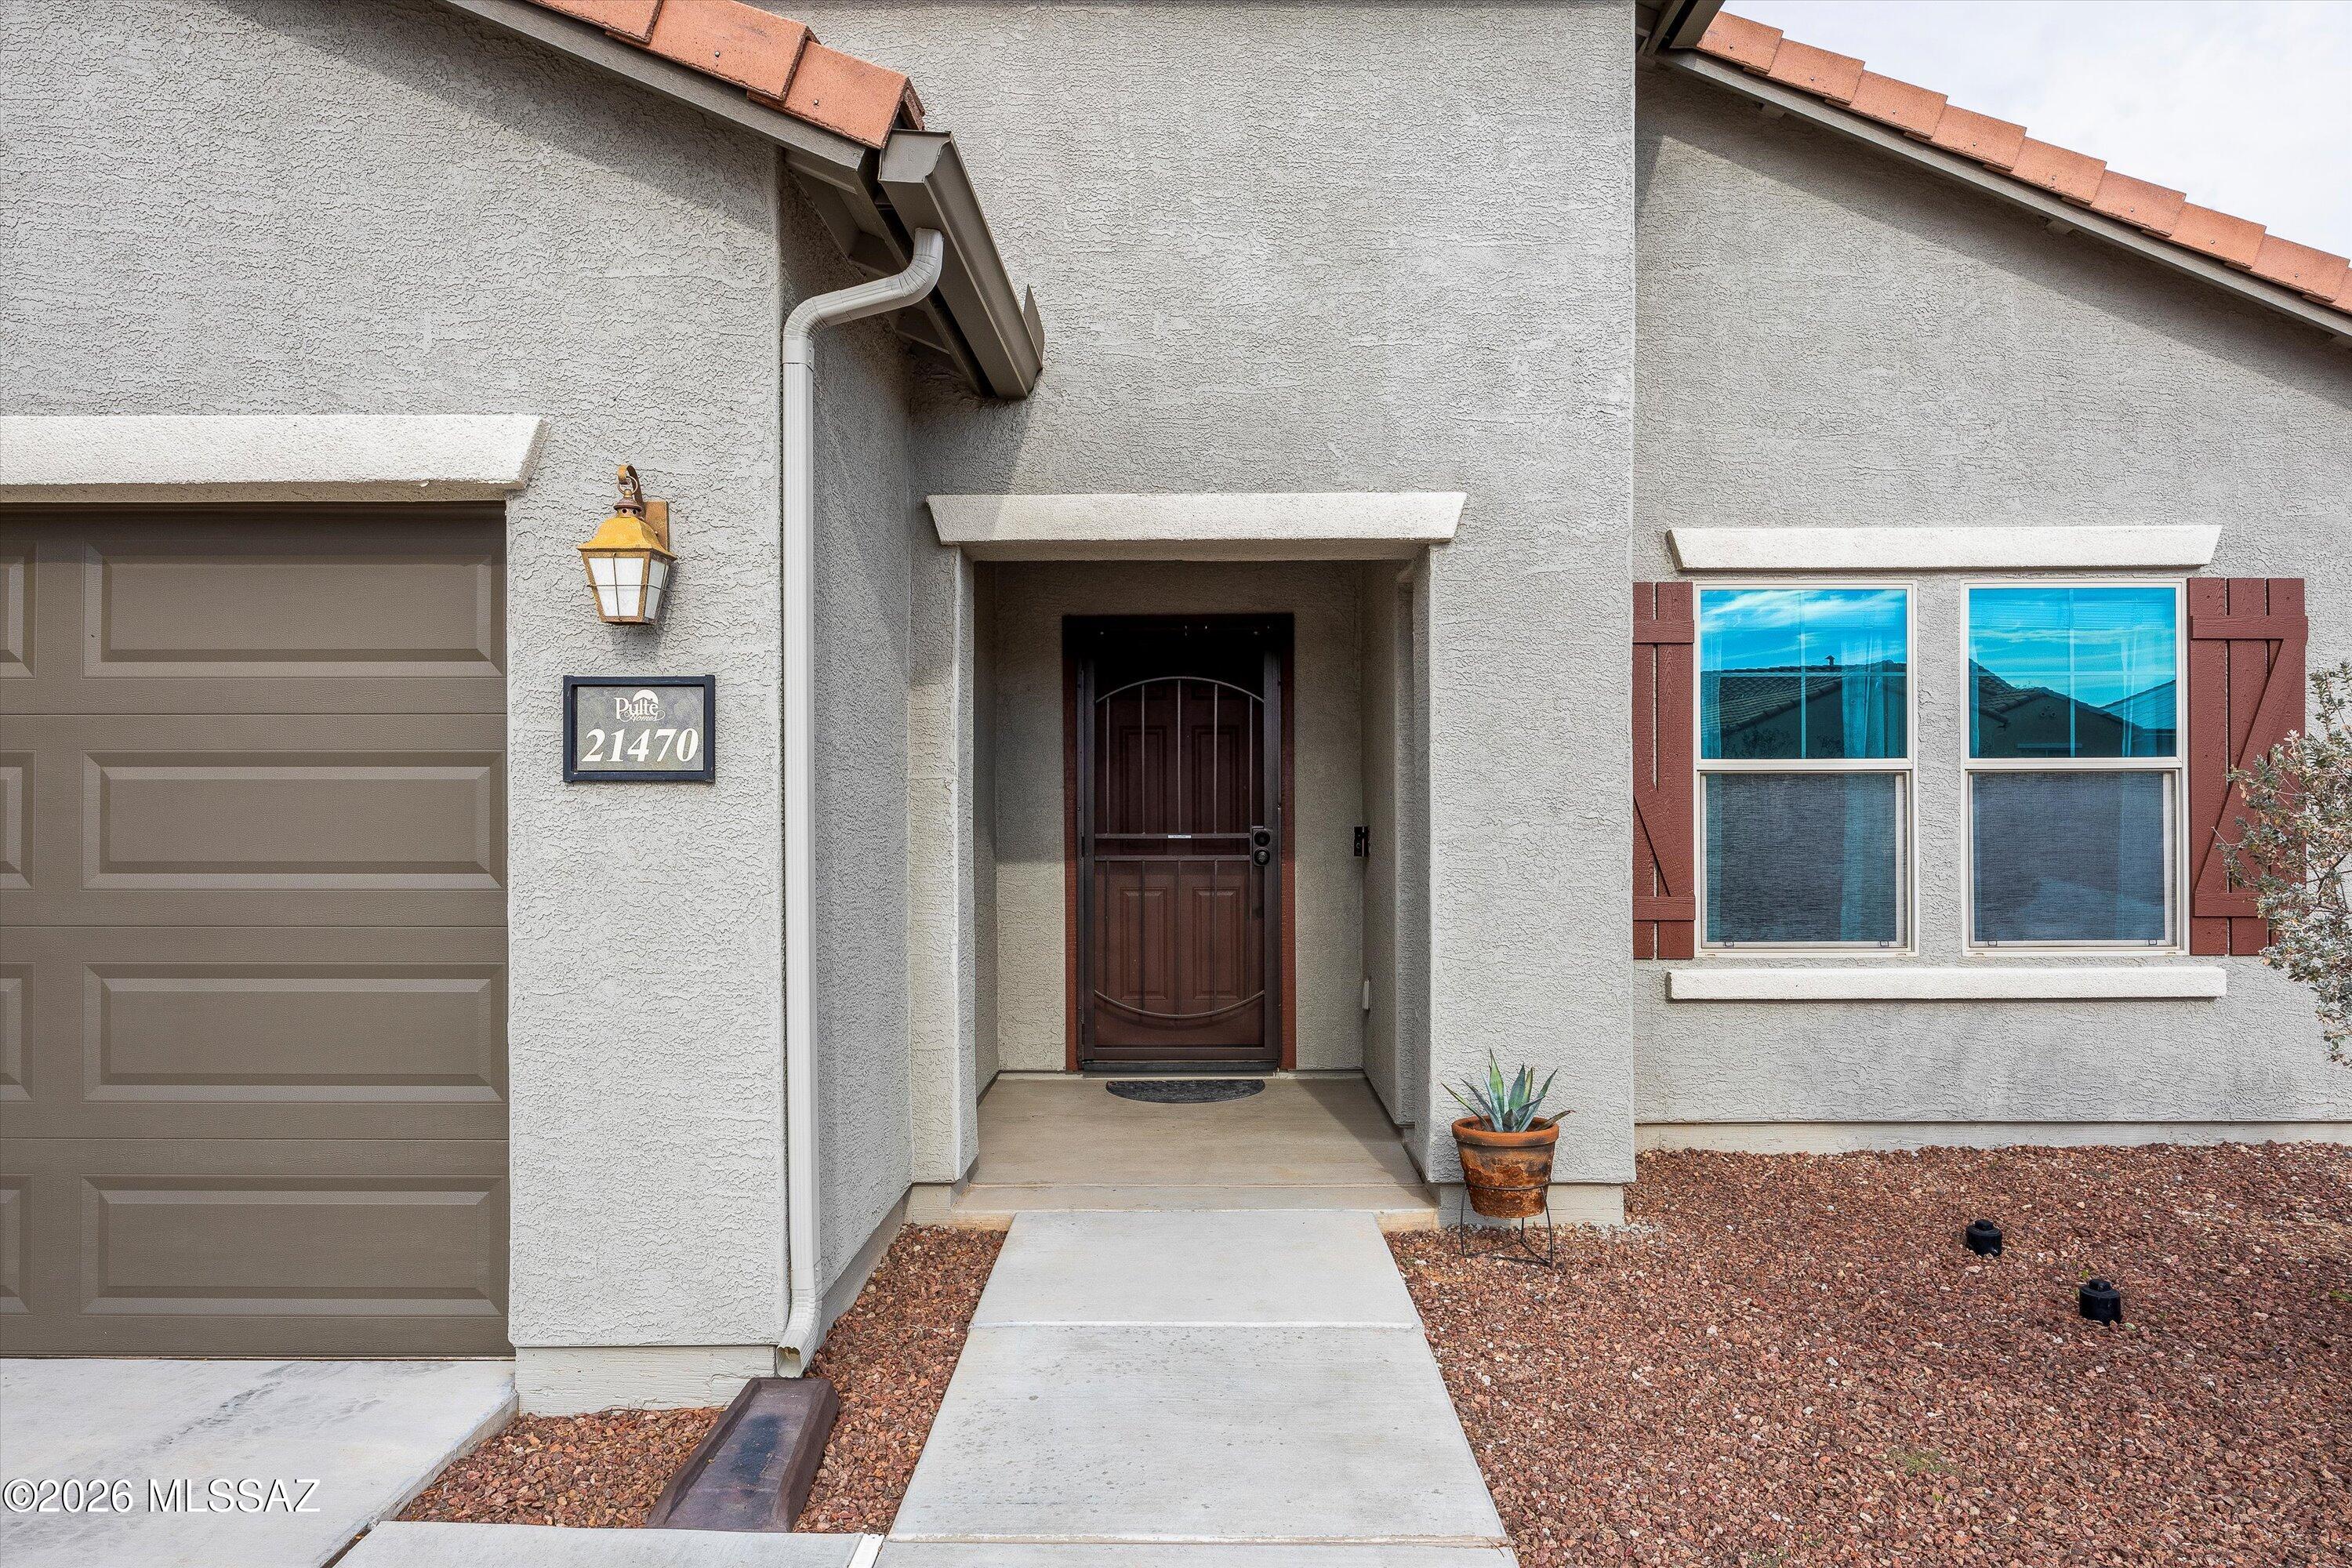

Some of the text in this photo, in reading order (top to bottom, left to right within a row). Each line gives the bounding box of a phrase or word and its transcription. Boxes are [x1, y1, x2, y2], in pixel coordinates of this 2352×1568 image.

[613, 697, 659, 719] Pulte
[619, 710, 666, 722] Homes
[581, 728, 699, 762] 21470
